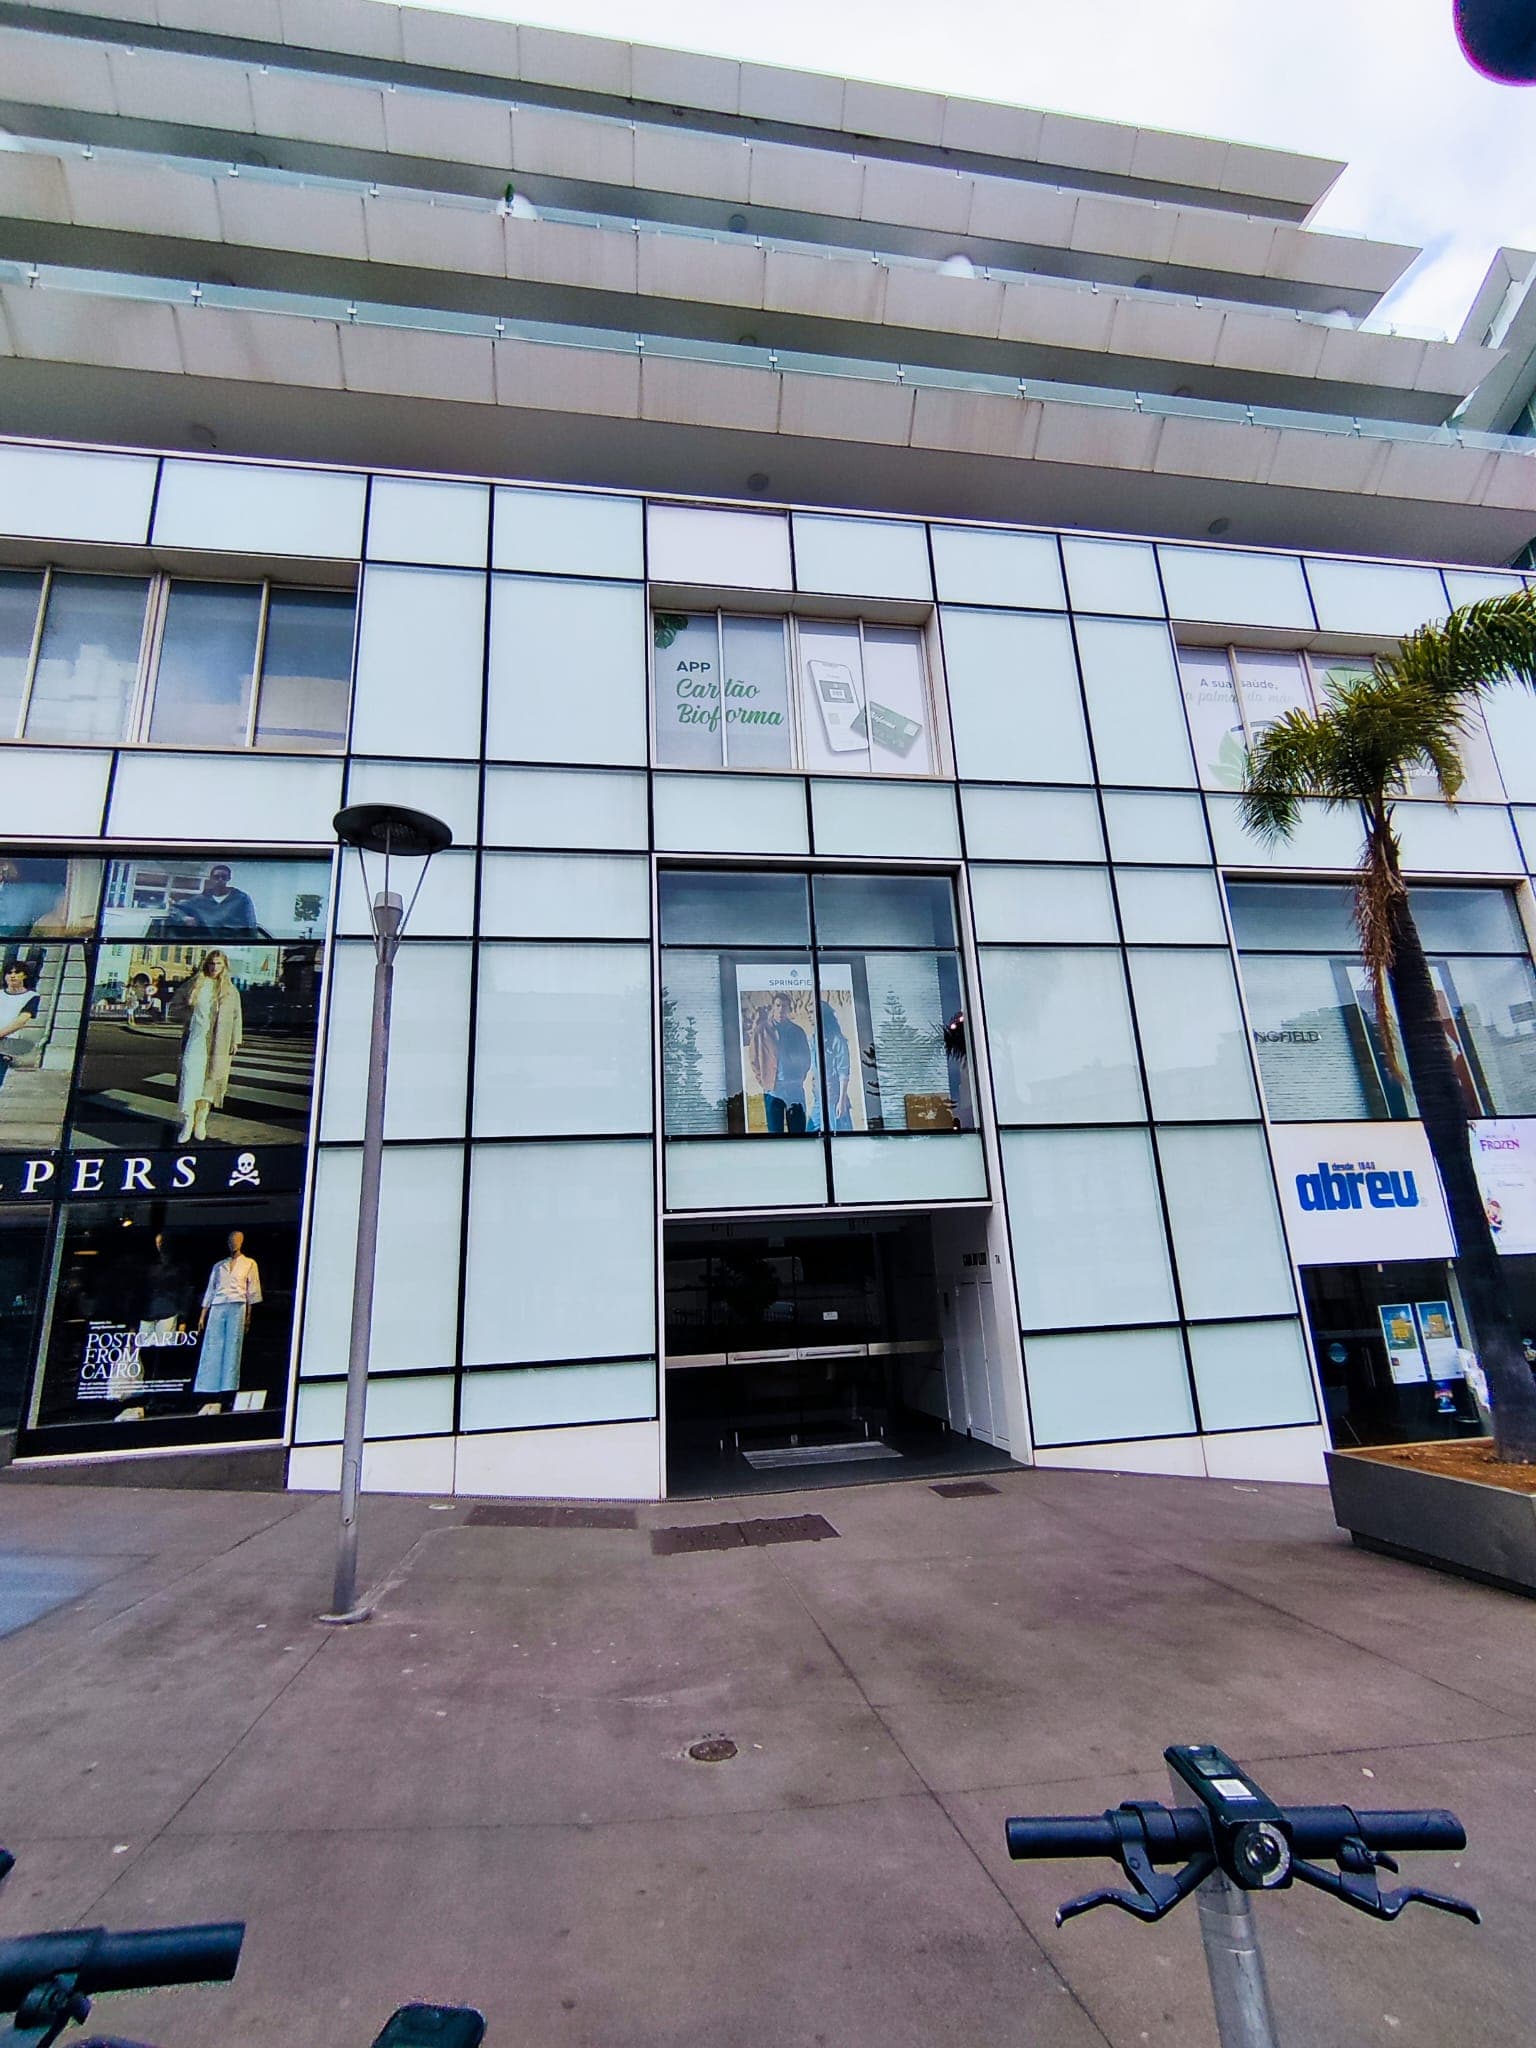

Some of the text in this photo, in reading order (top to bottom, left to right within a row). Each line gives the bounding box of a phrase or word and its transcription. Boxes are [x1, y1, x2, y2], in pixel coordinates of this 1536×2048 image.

[676, 660, 711, 673] APP
[676, 678, 760, 699] Cartão
[1200, 678, 1209, 688] A
[1211, 679, 1232, 689] sua
[677, 703, 784, 733] Bioforma
[768, 979, 822, 987] SPRINGFIE
[1479, 1139, 1520, 1152] FROZEN
[0, 1156, 197, 1193] PERS
[1296, 1162, 1419, 1211] abreu
[86, 1330, 199, 1349] POSTCARDS
[83, 1347, 140, 1364] FROM
[81, 1362, 141, 1380] CAIRO
